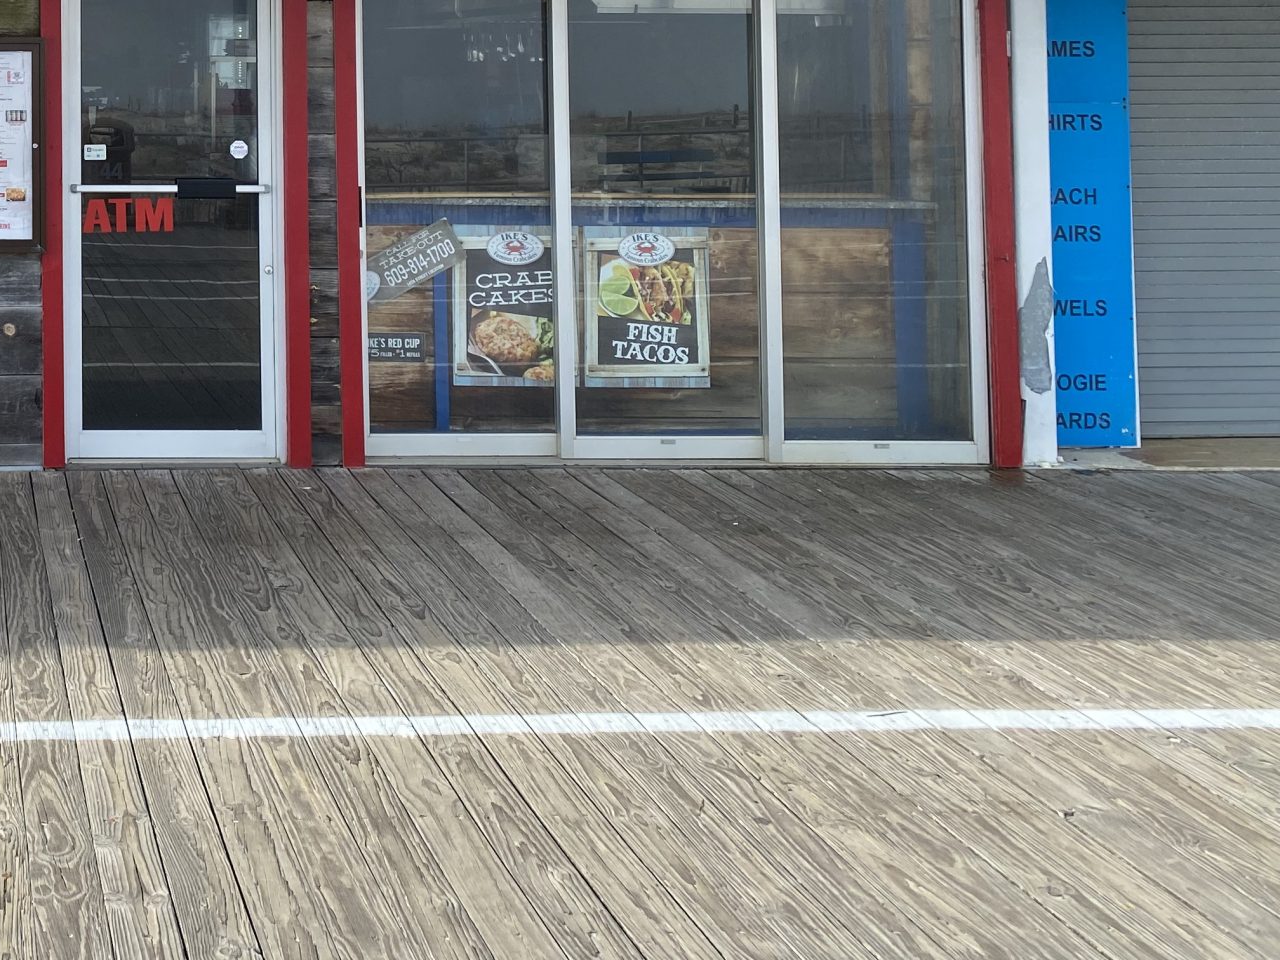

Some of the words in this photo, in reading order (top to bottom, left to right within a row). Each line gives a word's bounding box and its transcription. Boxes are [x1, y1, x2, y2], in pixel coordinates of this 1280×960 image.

[1051, 188, 1097, 205] ACH
[82, 197, 175, 234] ATM
[379, 230, 443, 269] TAKE-OUT
[383, 239, 455, 287] 609-814-1700
[475, 270, 553, 289] CRAB
[387, 338, 402, 348] RED
[404, 338, 420, 348] CUP
[626, 322, 679, 345] FISH
[612, 340, 690, 365] TACOS
